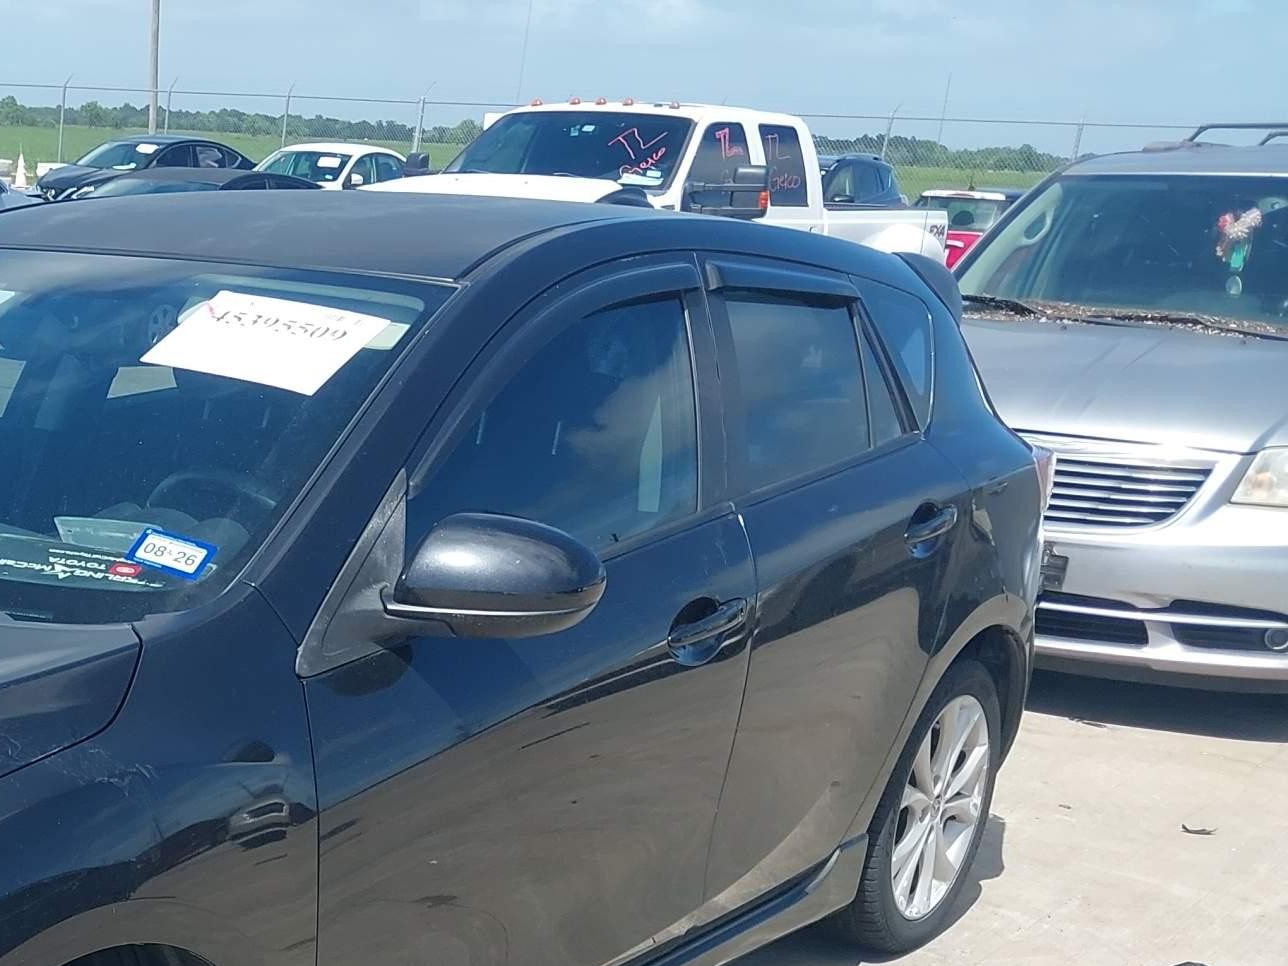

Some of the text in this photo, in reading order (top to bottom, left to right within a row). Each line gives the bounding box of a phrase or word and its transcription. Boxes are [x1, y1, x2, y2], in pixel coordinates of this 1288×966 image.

[608, 127, 669, 160] TL
[216, 310, 348, 341] 45395509
[48, 556, 106, 570] TOYOTA
[143, 542, 167, 557] 08
[173, 551, 198, 566] 26
